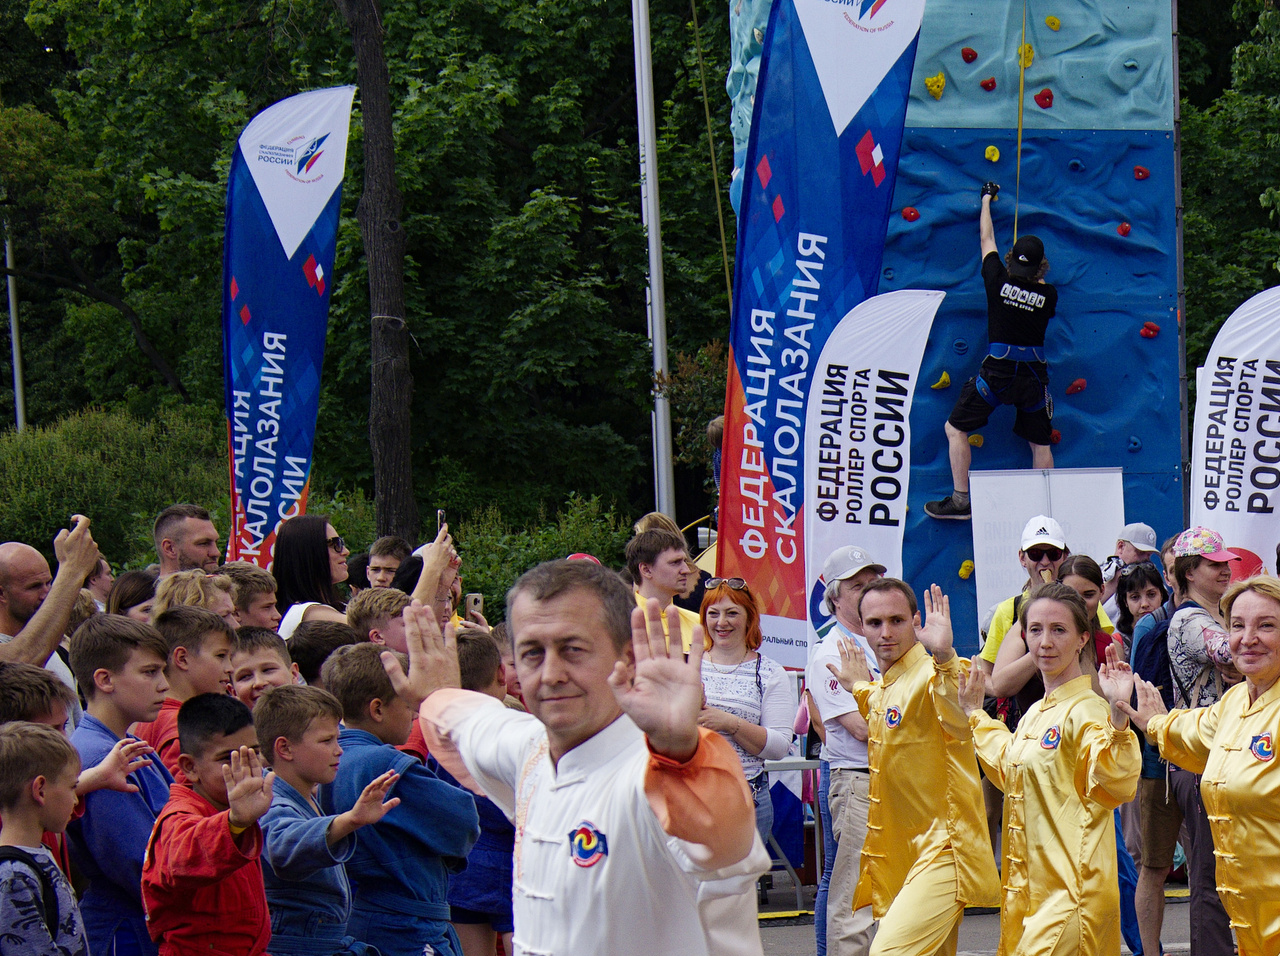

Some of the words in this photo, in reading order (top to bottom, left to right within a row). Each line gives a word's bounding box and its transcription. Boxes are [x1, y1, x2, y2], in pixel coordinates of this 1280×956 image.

[258, 155, 293, 165] РОССИИ
[773, 232, 828, 564] СКАЛОЛАЗАНИЯ
[849, 368, 872, 441] СПОРТА
[1203, 356, 1238, 511] ФЕДЕРАЦИЯ
[1233, 358, 1260, 433] СПОРТА
[738, 309, 776, 560] ФЕДЕРАЦИЯ
[815, 363, 849, 522] ФЕДЕРАЦИЯ
[868, 369, 910, 527] РОССИИ
[845, 448, 866, 524] РОЛЛЕР
[1225, 437, 1247, 513] РОЛЛЕР
[762, 635, 794, 646] РАЛЬНЫЙ
